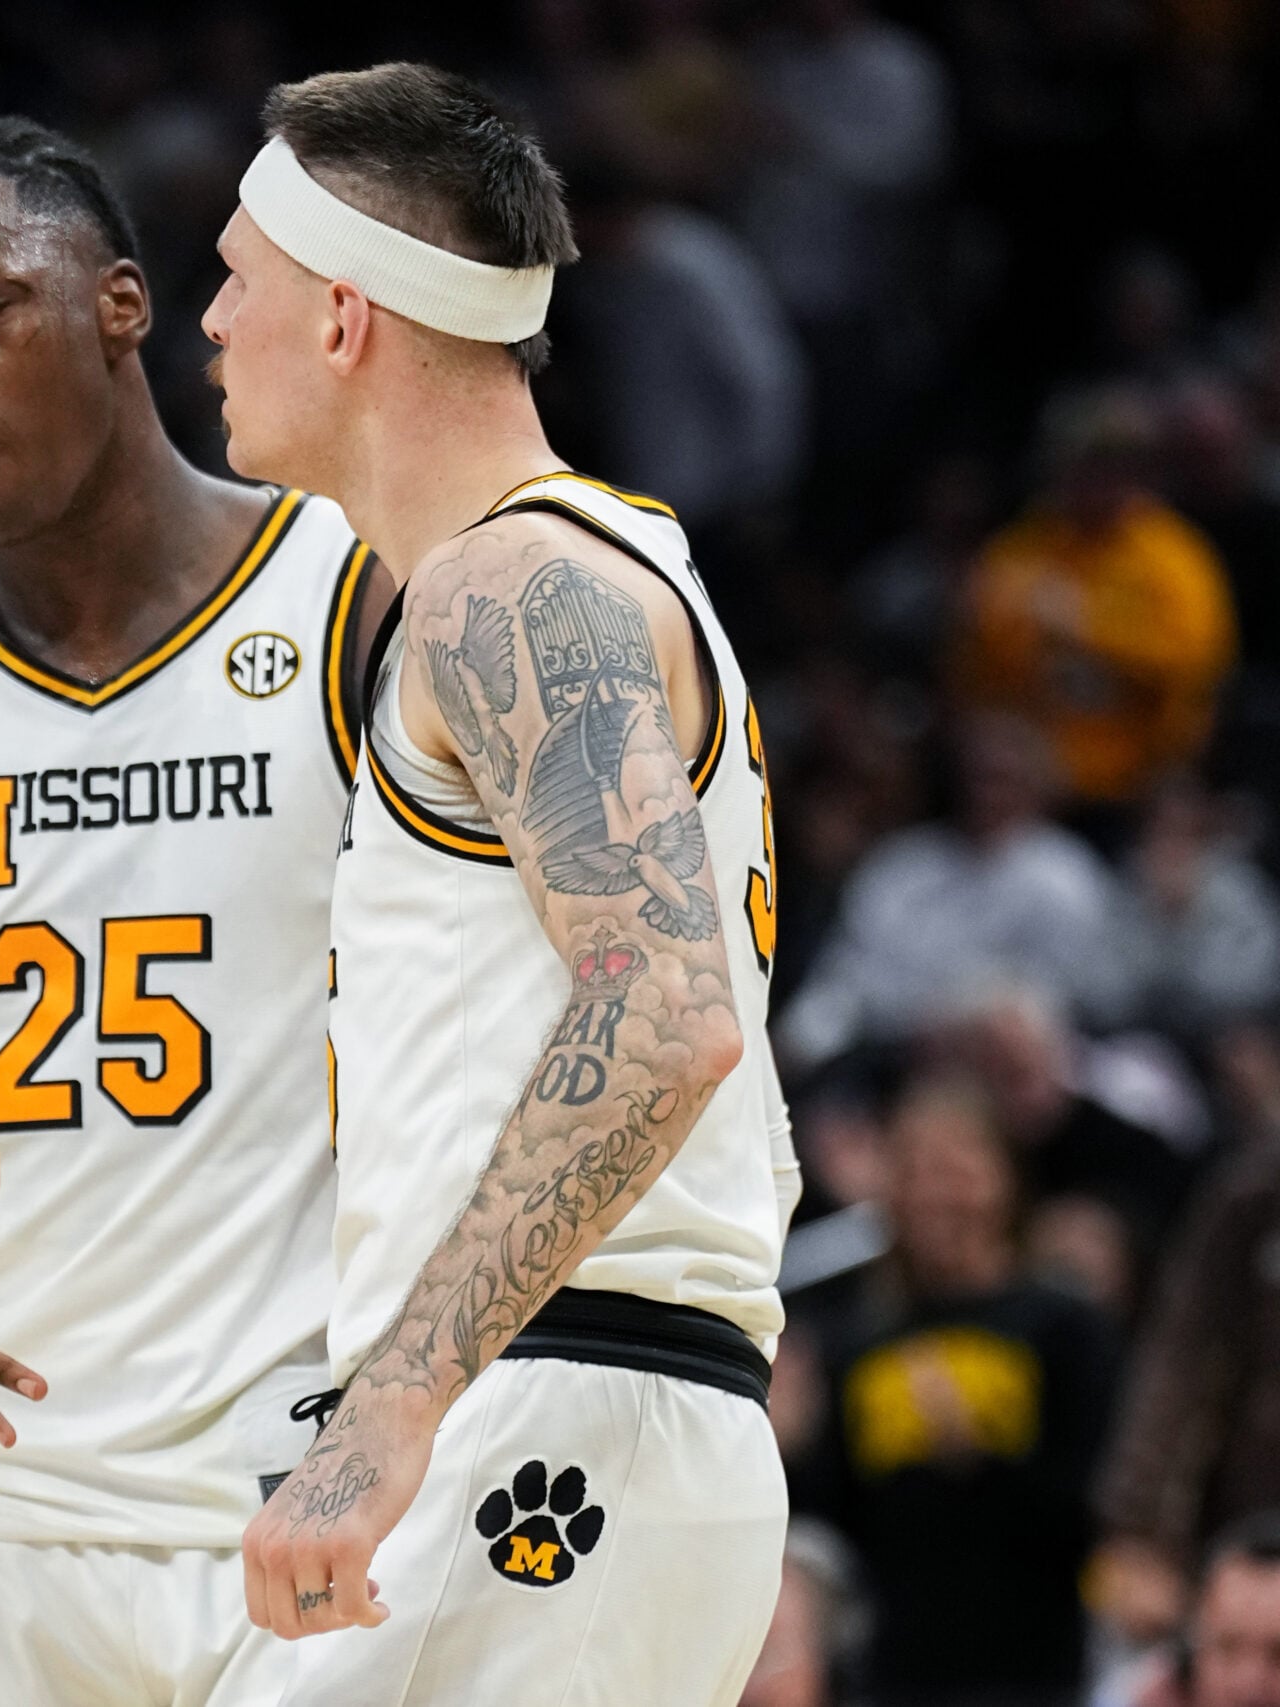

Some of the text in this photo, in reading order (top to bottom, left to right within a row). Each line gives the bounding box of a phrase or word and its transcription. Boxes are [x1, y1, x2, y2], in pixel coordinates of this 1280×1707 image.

[231, 634, 298, 695] SEC
[546, 998, 625, 1061] EAR
[532, 1053, 606, 1106] OD
[504, 1535, 560, 1581] M
